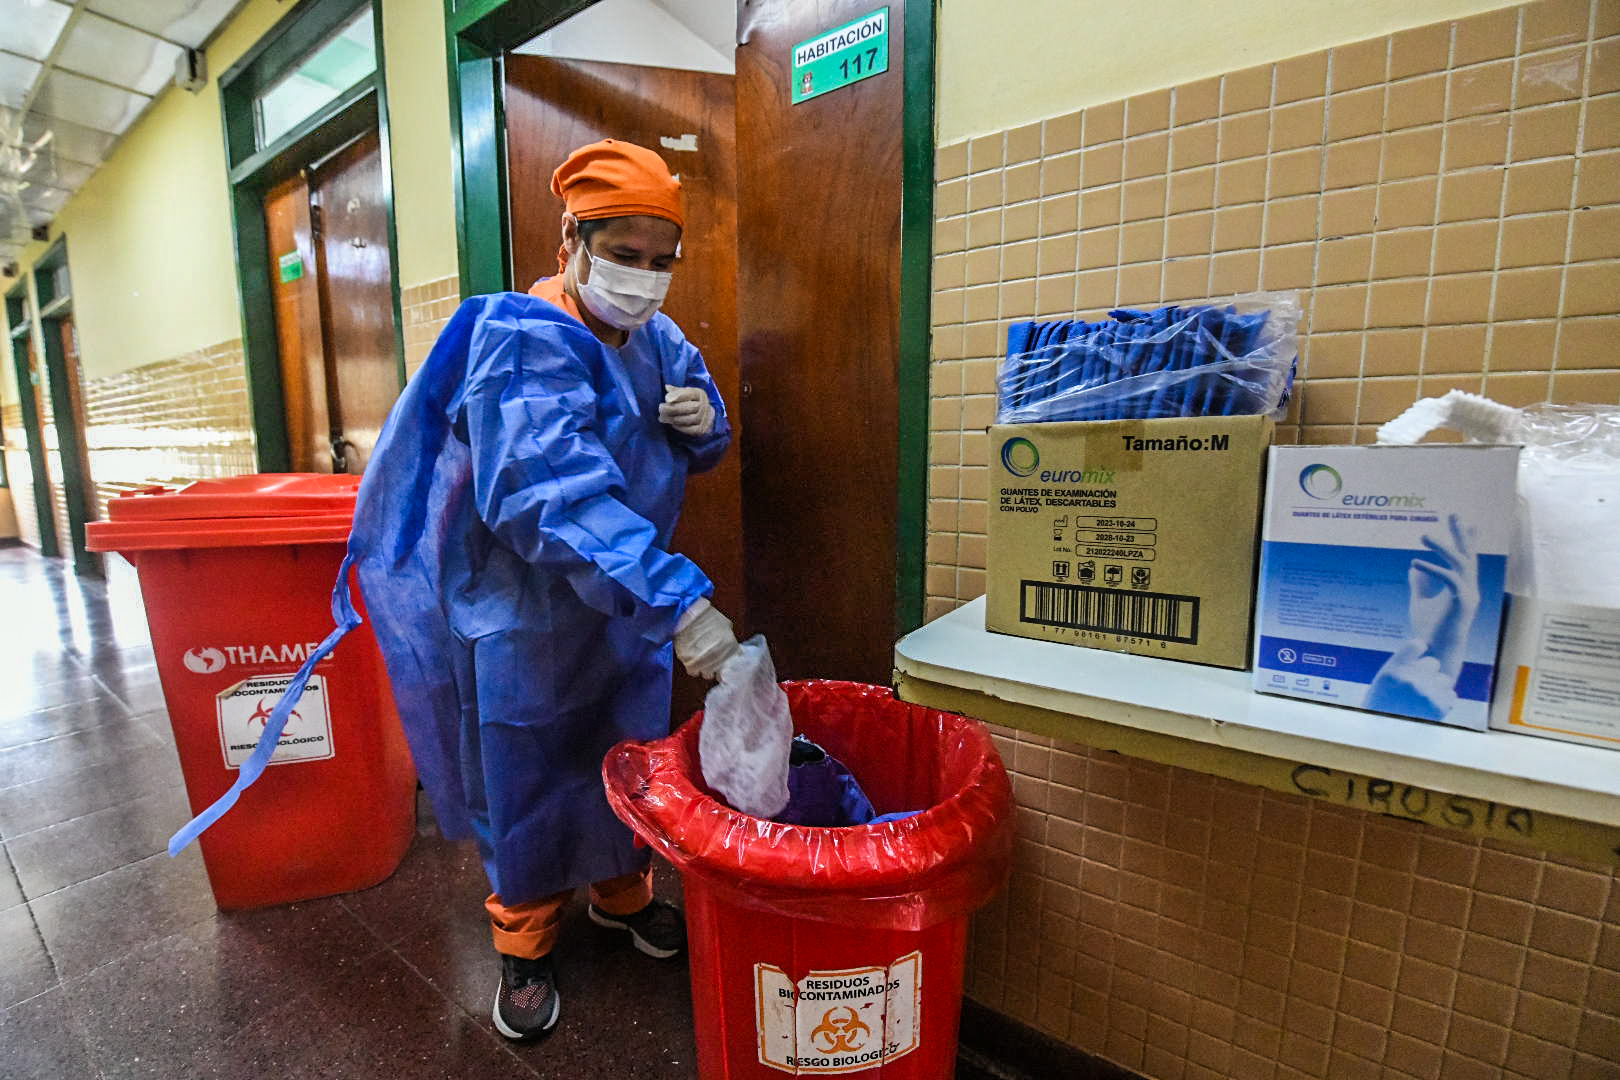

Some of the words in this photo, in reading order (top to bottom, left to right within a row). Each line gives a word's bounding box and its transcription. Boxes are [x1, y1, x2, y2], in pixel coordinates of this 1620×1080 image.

[797, 19, 882, 65] HABITACIÓN
[839, 47, 878, 80] 117
[1122, 434, 1229, 451] Tamaño:M
[1040, 467, 1116, 484] euromix
[1000, 488, 1040, 497] GUANTES
[1041, 489, 1053, 497] DE
[1054, 489, 1117, 499] EXAMINACIÓN
[1342, 492, 1426, 508] euromix
[1000, 497, 1012, 505] DE
[1014, 496, 1043, 507] LÁTEX,
[1045, 498, 1117, 508] DESCARTABLES
[1096, 519, 1136, 528] 2023-10-24
[1096, 533, 1135, 542] 2028-10-23
[246, 679, 290, 688] RESIDUO
[806, 976, 870, 990] RESIDUOS
